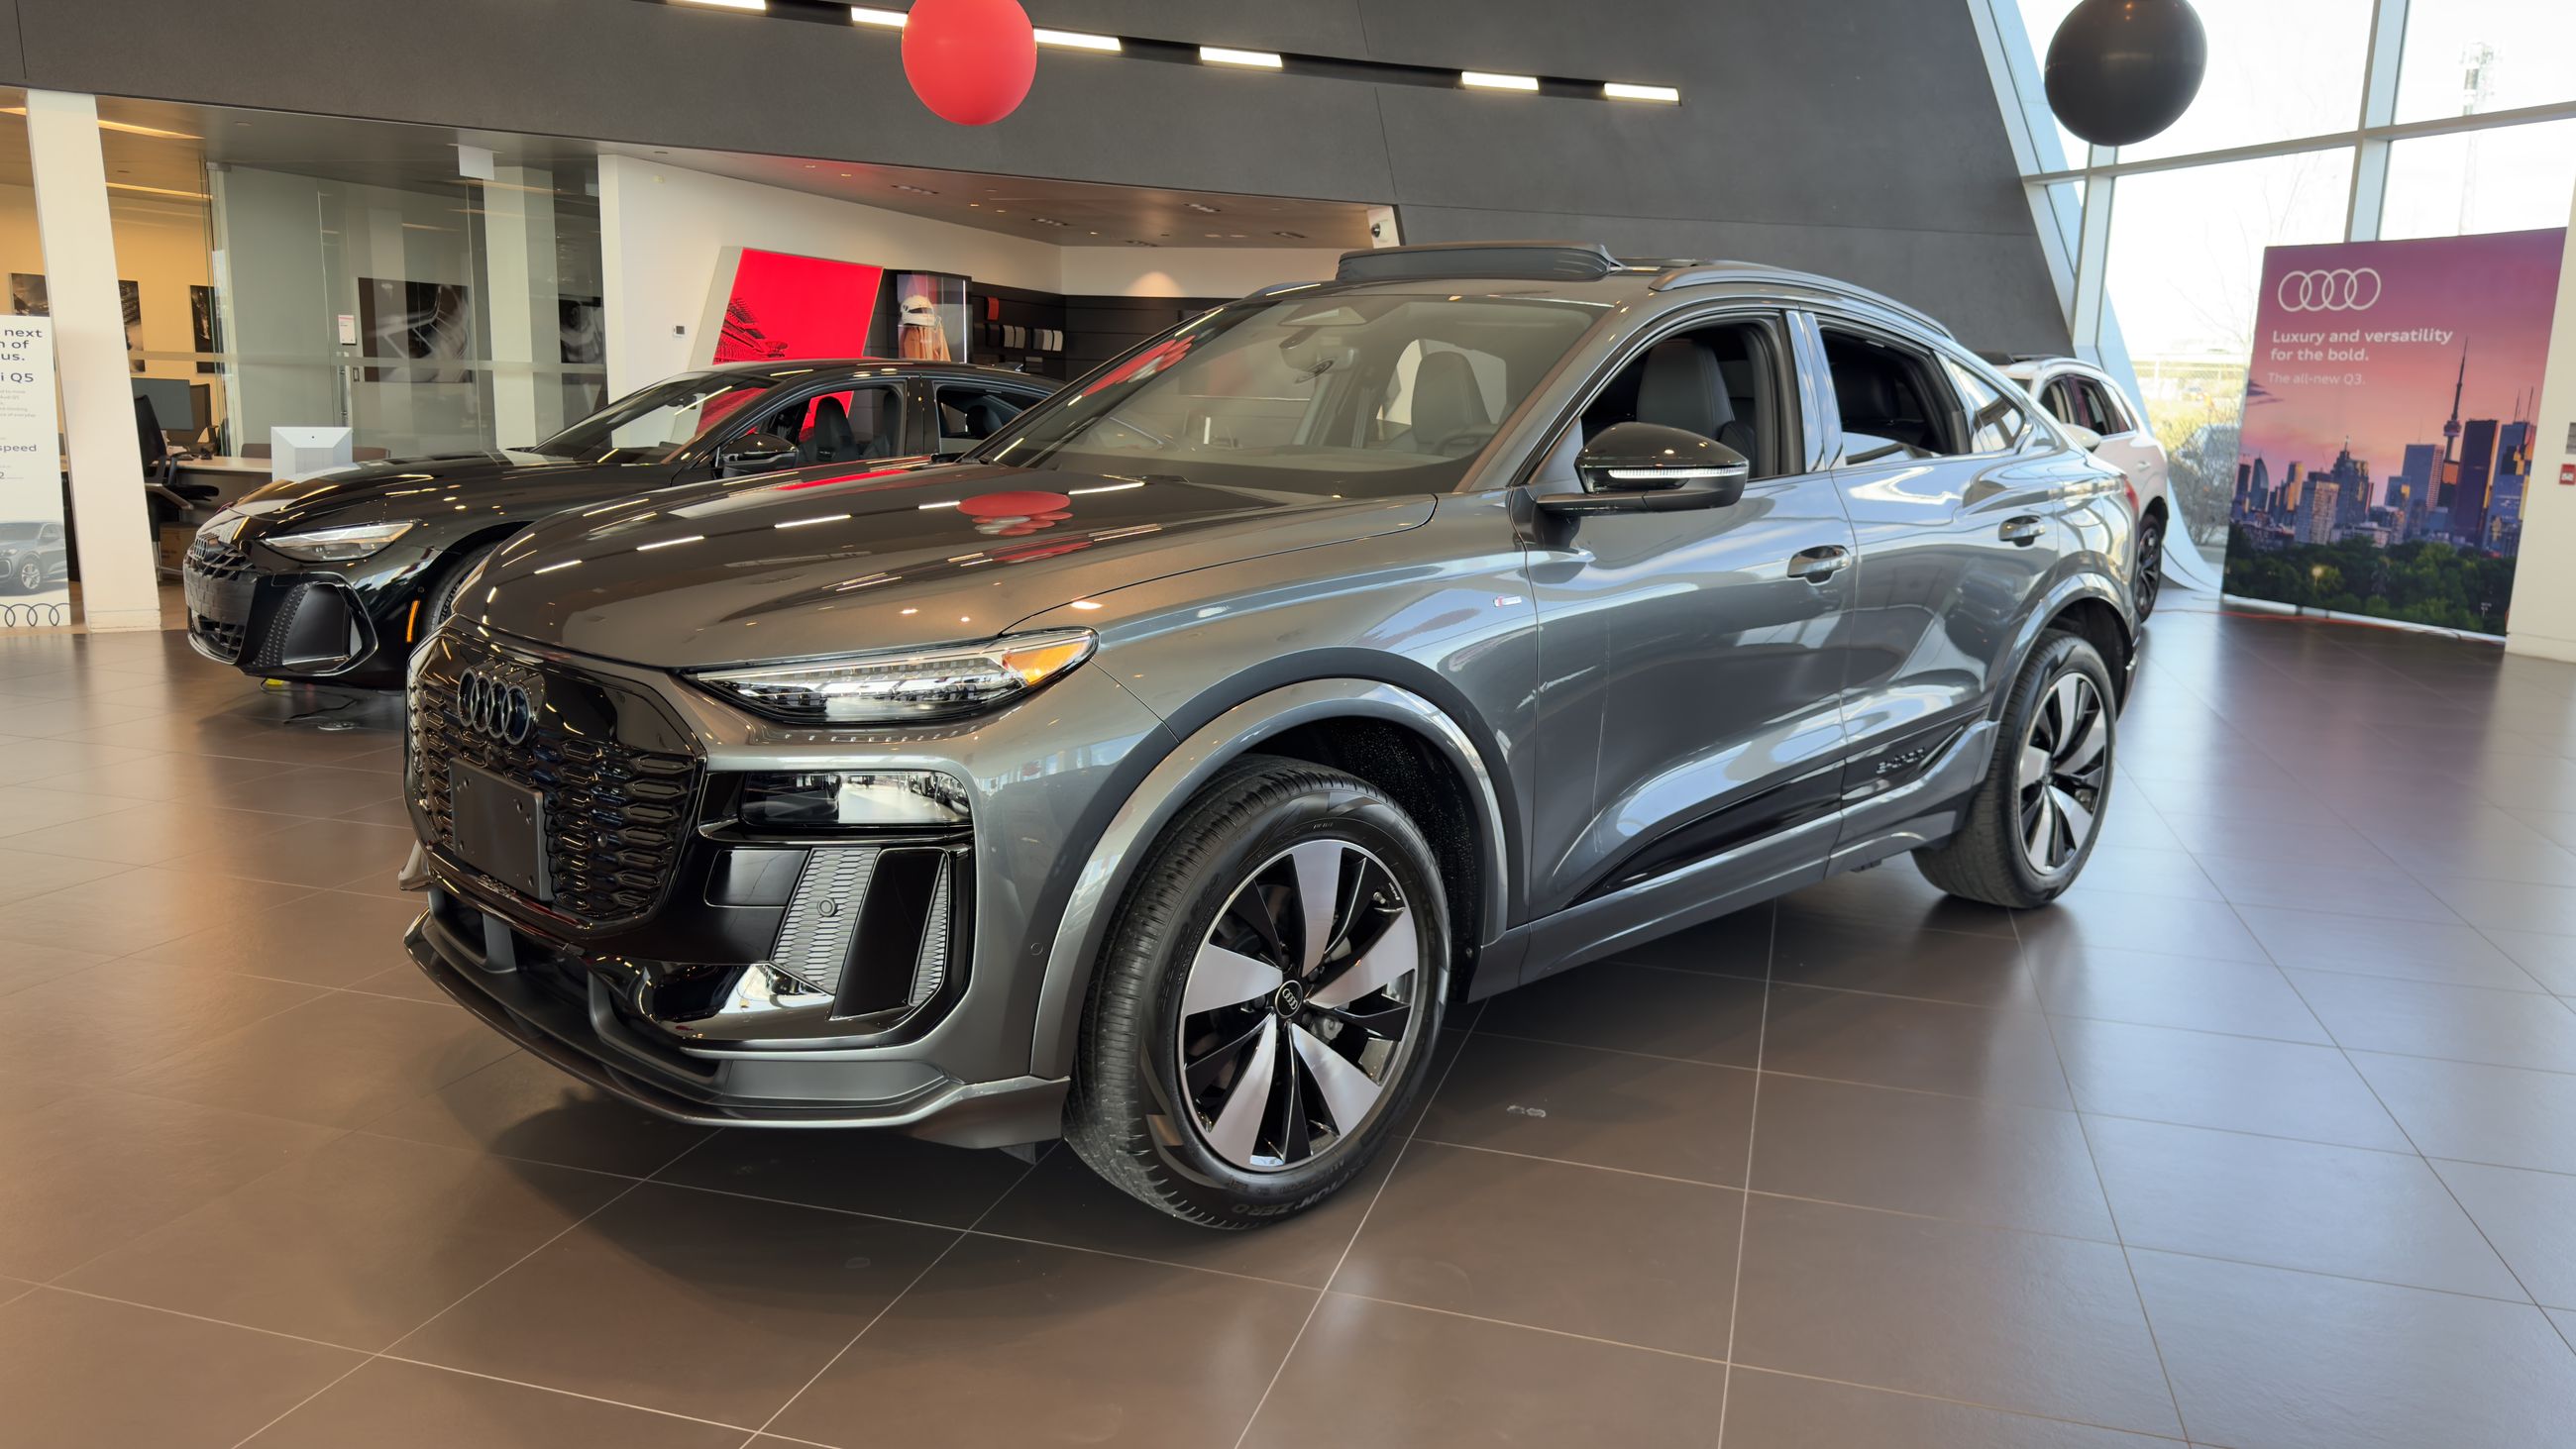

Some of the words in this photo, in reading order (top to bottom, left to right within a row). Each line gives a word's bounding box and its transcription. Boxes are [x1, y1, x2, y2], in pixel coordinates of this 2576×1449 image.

[4, 329, 43, 338] next
[2272, 330, 2325, 346] Luxury
[2329, 330, 2359, 343] and
[2364, 328, 2453, 345] versatility
[11, 340, 30, 349] of
[2270, 349, 2293, 362] for
[2298, 349, 2323, 362] the
[2327, 348, 2369, 362] bold.
[10, 372, 35, 383] Q5
[2268, 372, 2291, 384] The
[2293, 372, 2341, 385] all-new
[2343, 373, 2366, 386] Q3.
